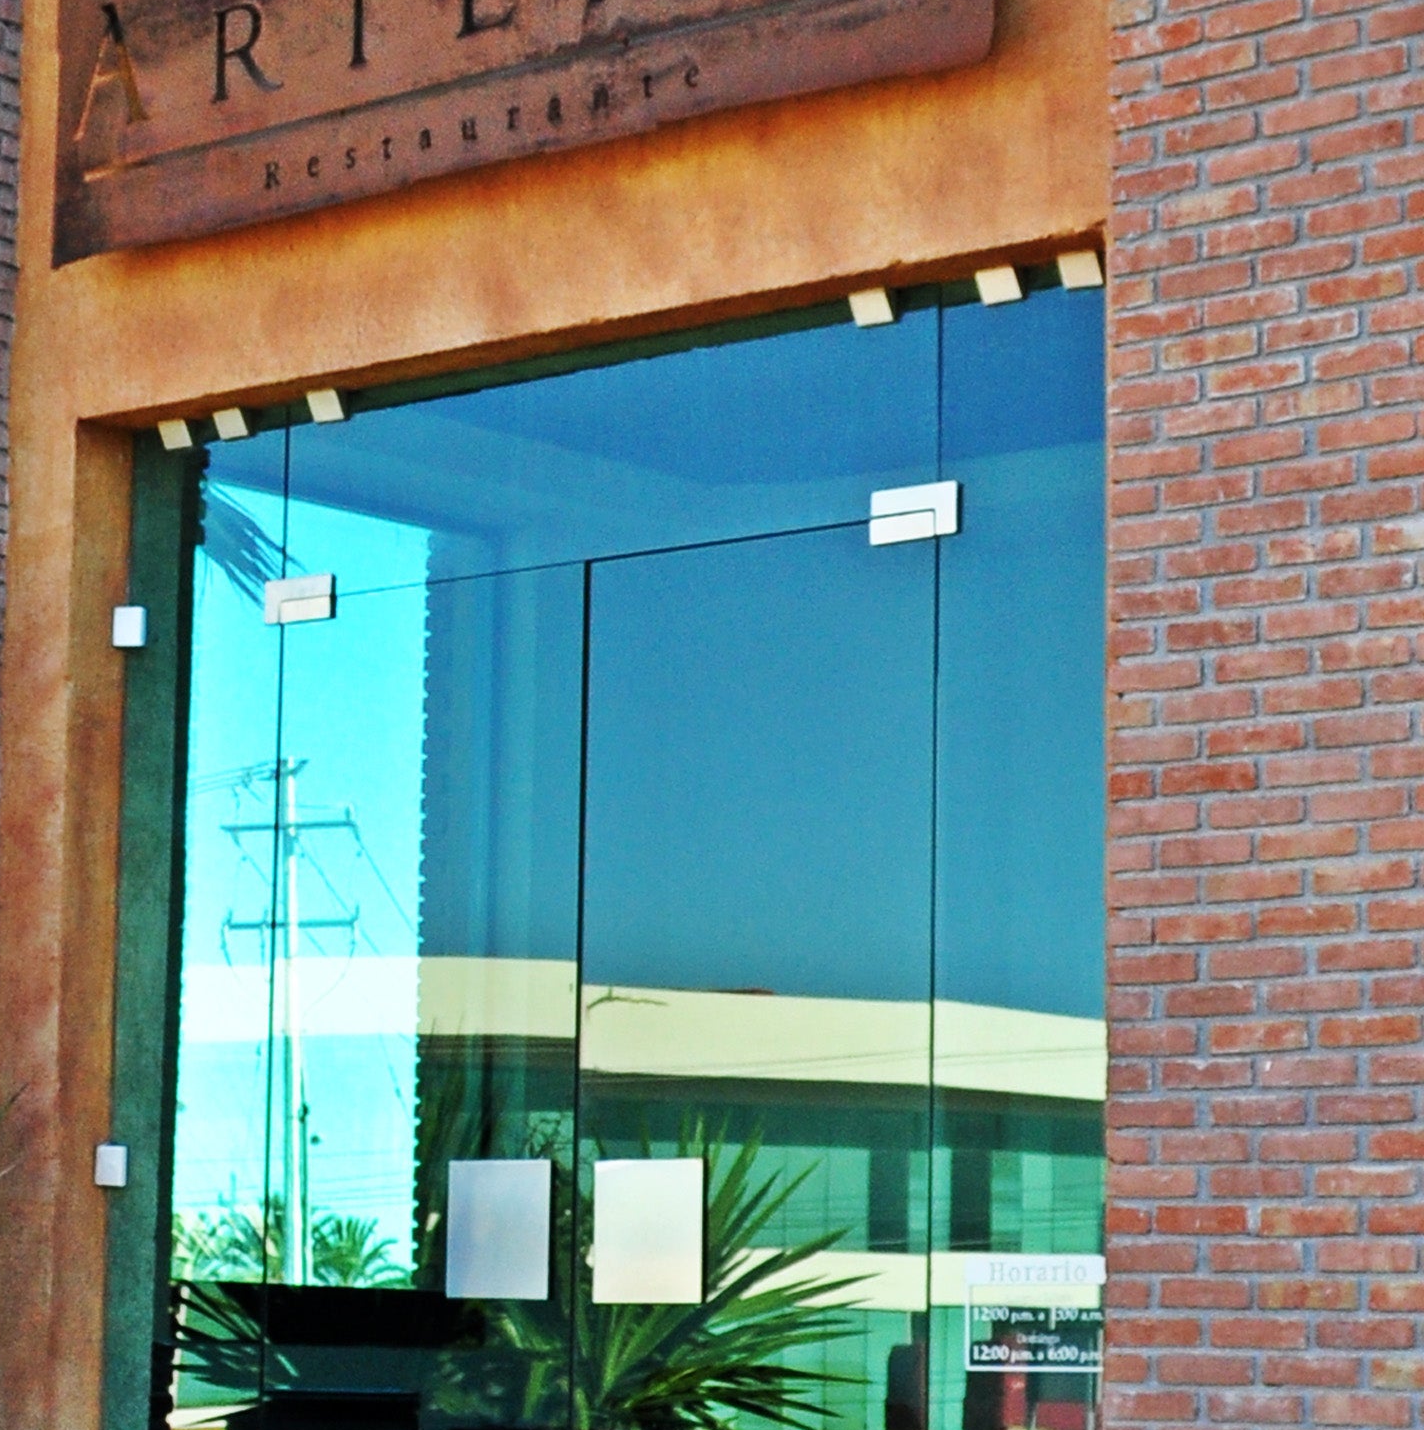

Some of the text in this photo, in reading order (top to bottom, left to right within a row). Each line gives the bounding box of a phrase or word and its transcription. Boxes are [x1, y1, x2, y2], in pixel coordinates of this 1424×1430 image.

[264, 57, 700, 190] Restaurante
[989, 1261, 1087, 1283] Horario
[972, 1306, 1010, 1322] 12:00
[972, 1345, 1010, 1361] 12:00
[1047, 1345, 1079, 1362] 6:00
